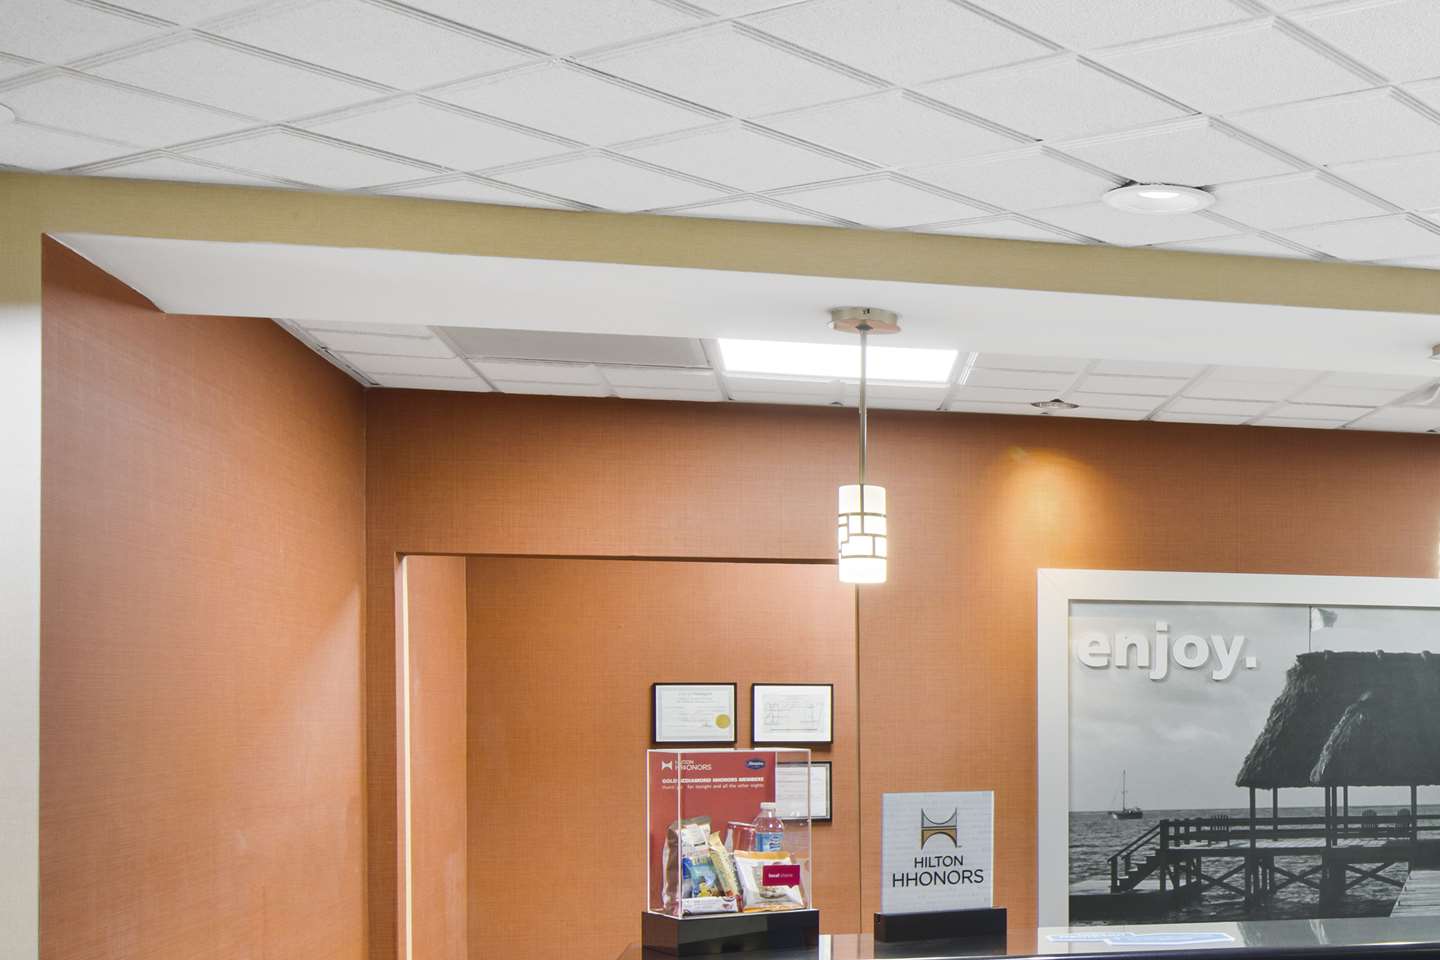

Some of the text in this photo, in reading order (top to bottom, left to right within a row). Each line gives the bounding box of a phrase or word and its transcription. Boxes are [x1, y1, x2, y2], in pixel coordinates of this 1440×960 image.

[1076, 621, 1257, 681] enjoy.
[914, 855, 964, 868] HILTON
[892, 868, 984, 888] HHONORS
